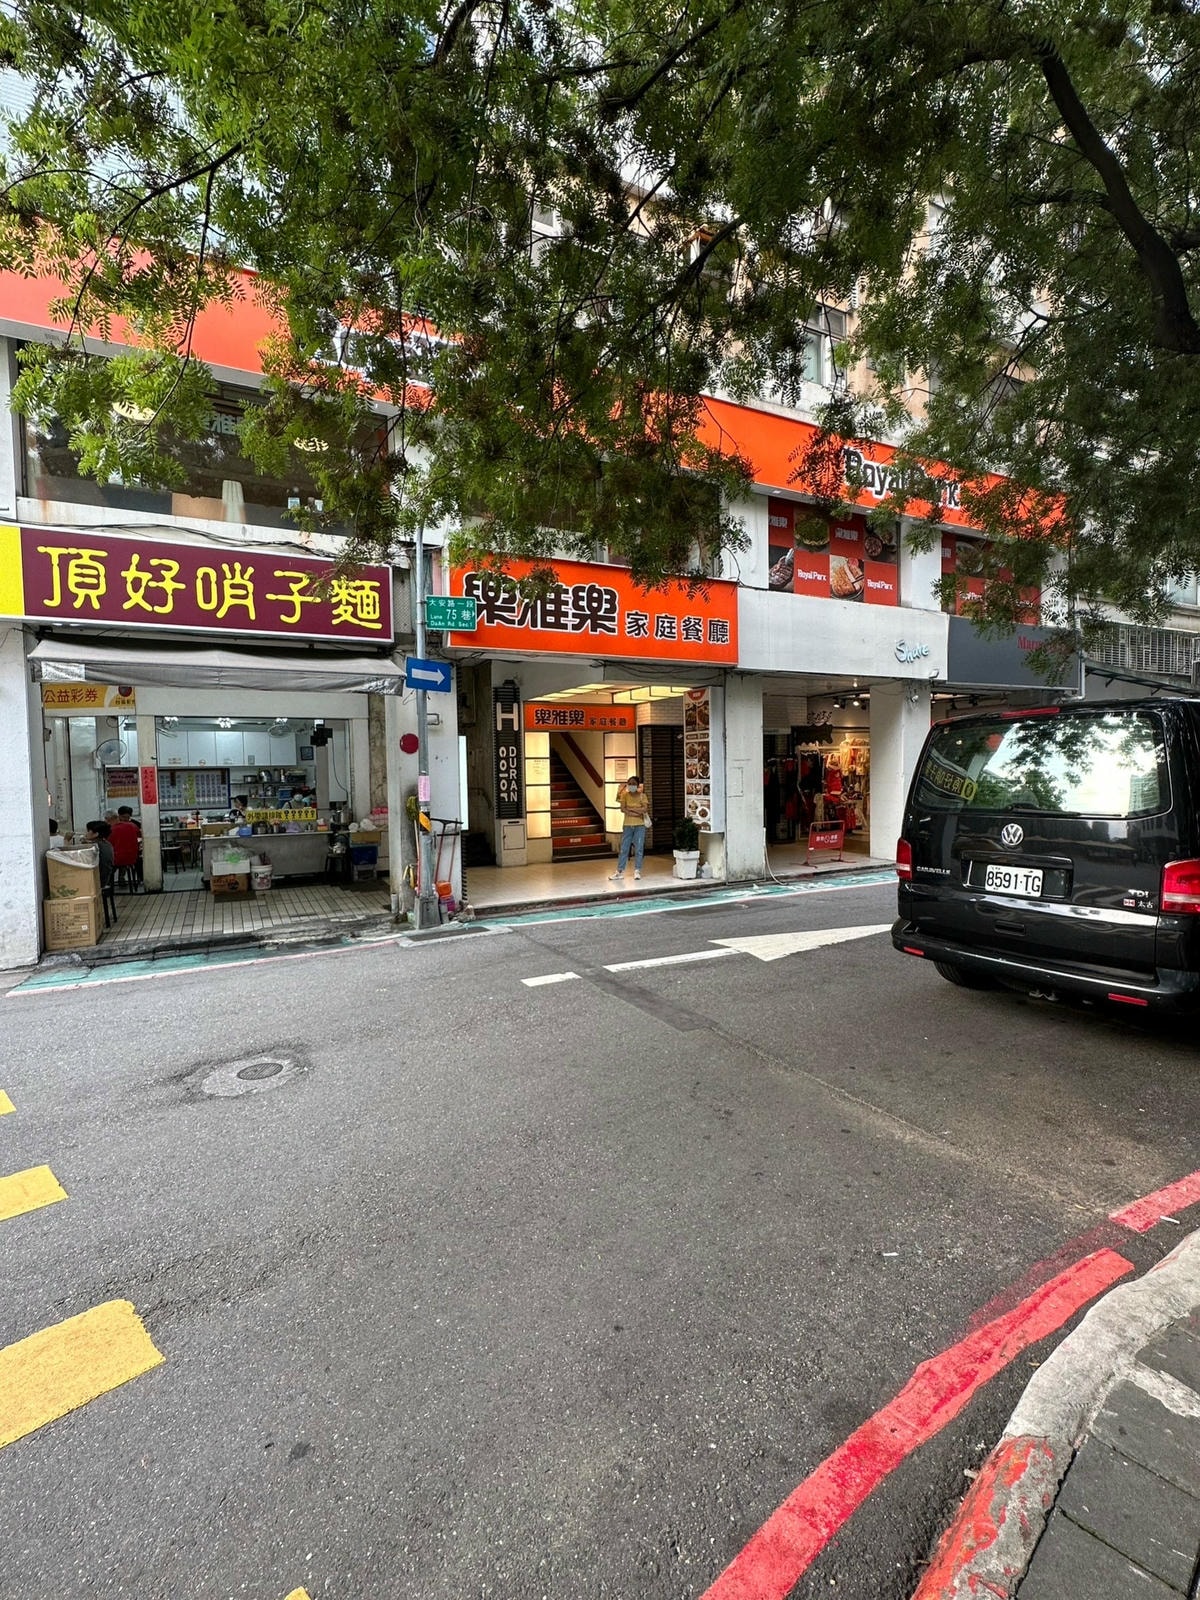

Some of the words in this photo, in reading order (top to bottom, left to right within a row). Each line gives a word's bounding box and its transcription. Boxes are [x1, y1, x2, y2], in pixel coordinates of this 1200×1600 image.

[37, 545, 383, 629] 頂好哨子麵
[429, 599, 474, 608] 大安路一段
[446, 609, 457, 620] 75
[461, 609, 471, 620] 巷
[626, 610, 730, 645] 家庭餐廳
[43, 687, 99, 704] 公益彩券
[496, 702, 519, 731] H
[535, 708, 585, 726] 樂雅樂
[509, 746, 518, 802] DURAN
[1127, 889, 1149, 898] TDI
